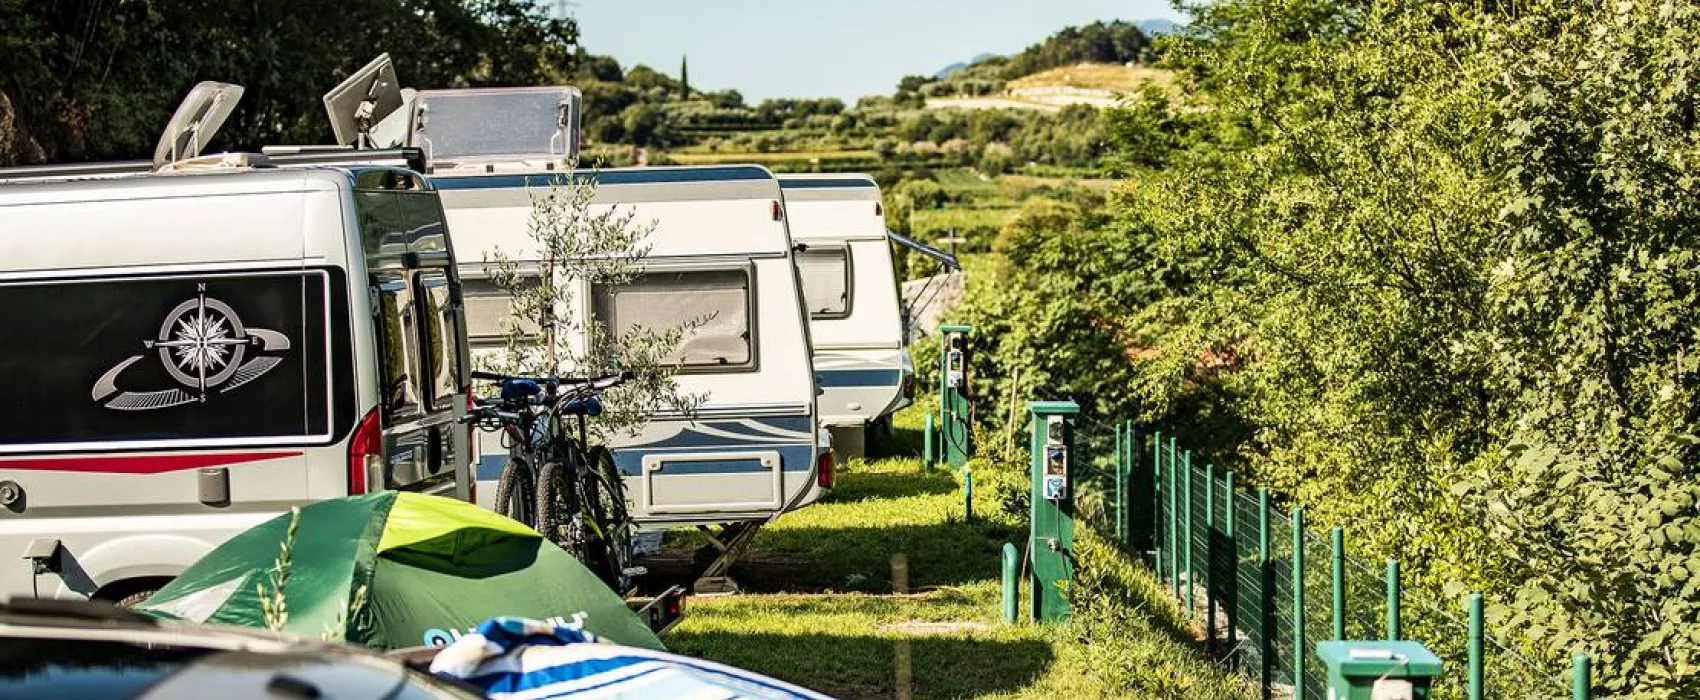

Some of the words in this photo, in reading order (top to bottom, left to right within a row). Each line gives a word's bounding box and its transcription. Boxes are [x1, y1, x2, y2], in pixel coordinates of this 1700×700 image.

[197, 282, 206, 292] N
[143, 340, 154, 349] W
[252, 336, 259, 345] E
[200, 393, 206, 403] S
